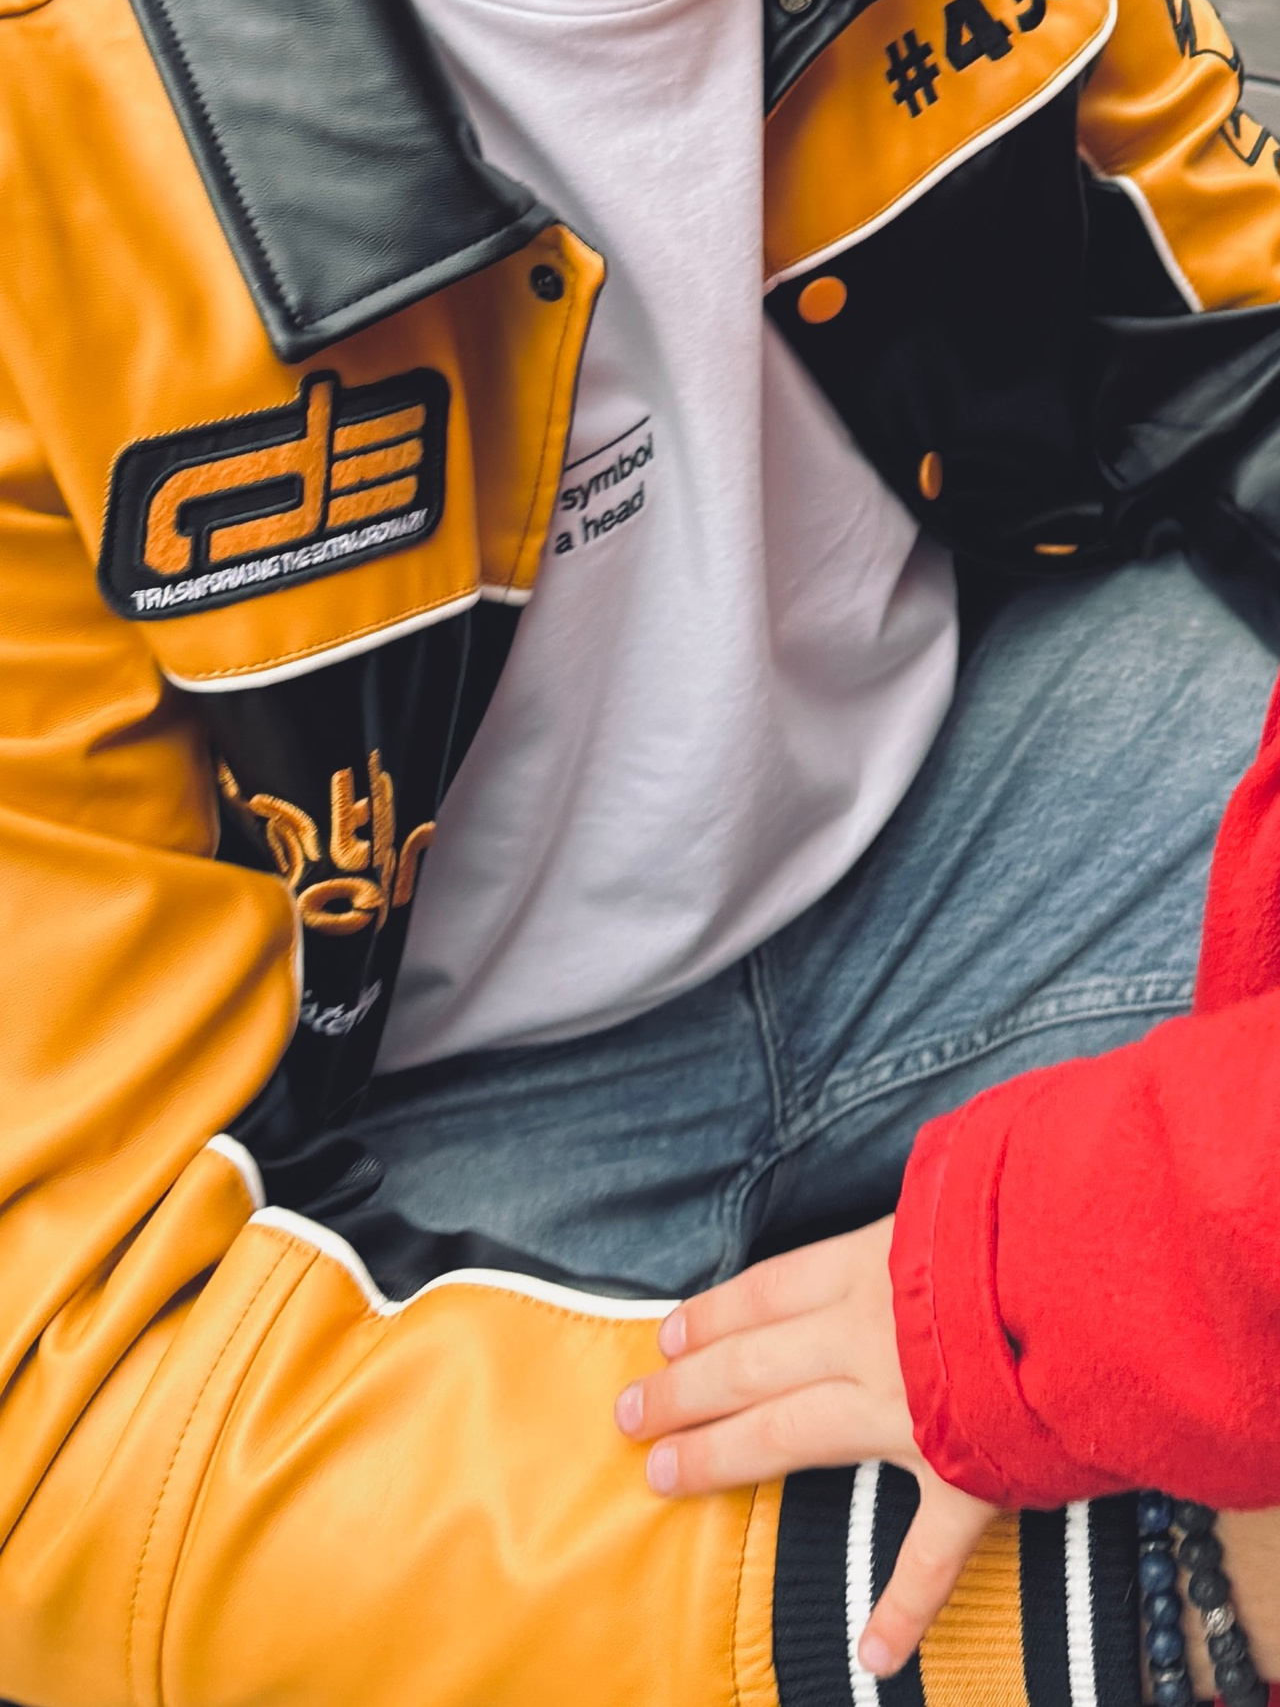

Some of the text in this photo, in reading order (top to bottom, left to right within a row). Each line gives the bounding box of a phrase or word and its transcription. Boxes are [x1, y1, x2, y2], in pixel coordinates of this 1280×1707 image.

[560, 432, 654, 511] symbol
[555, 481, 645, 554] a head
